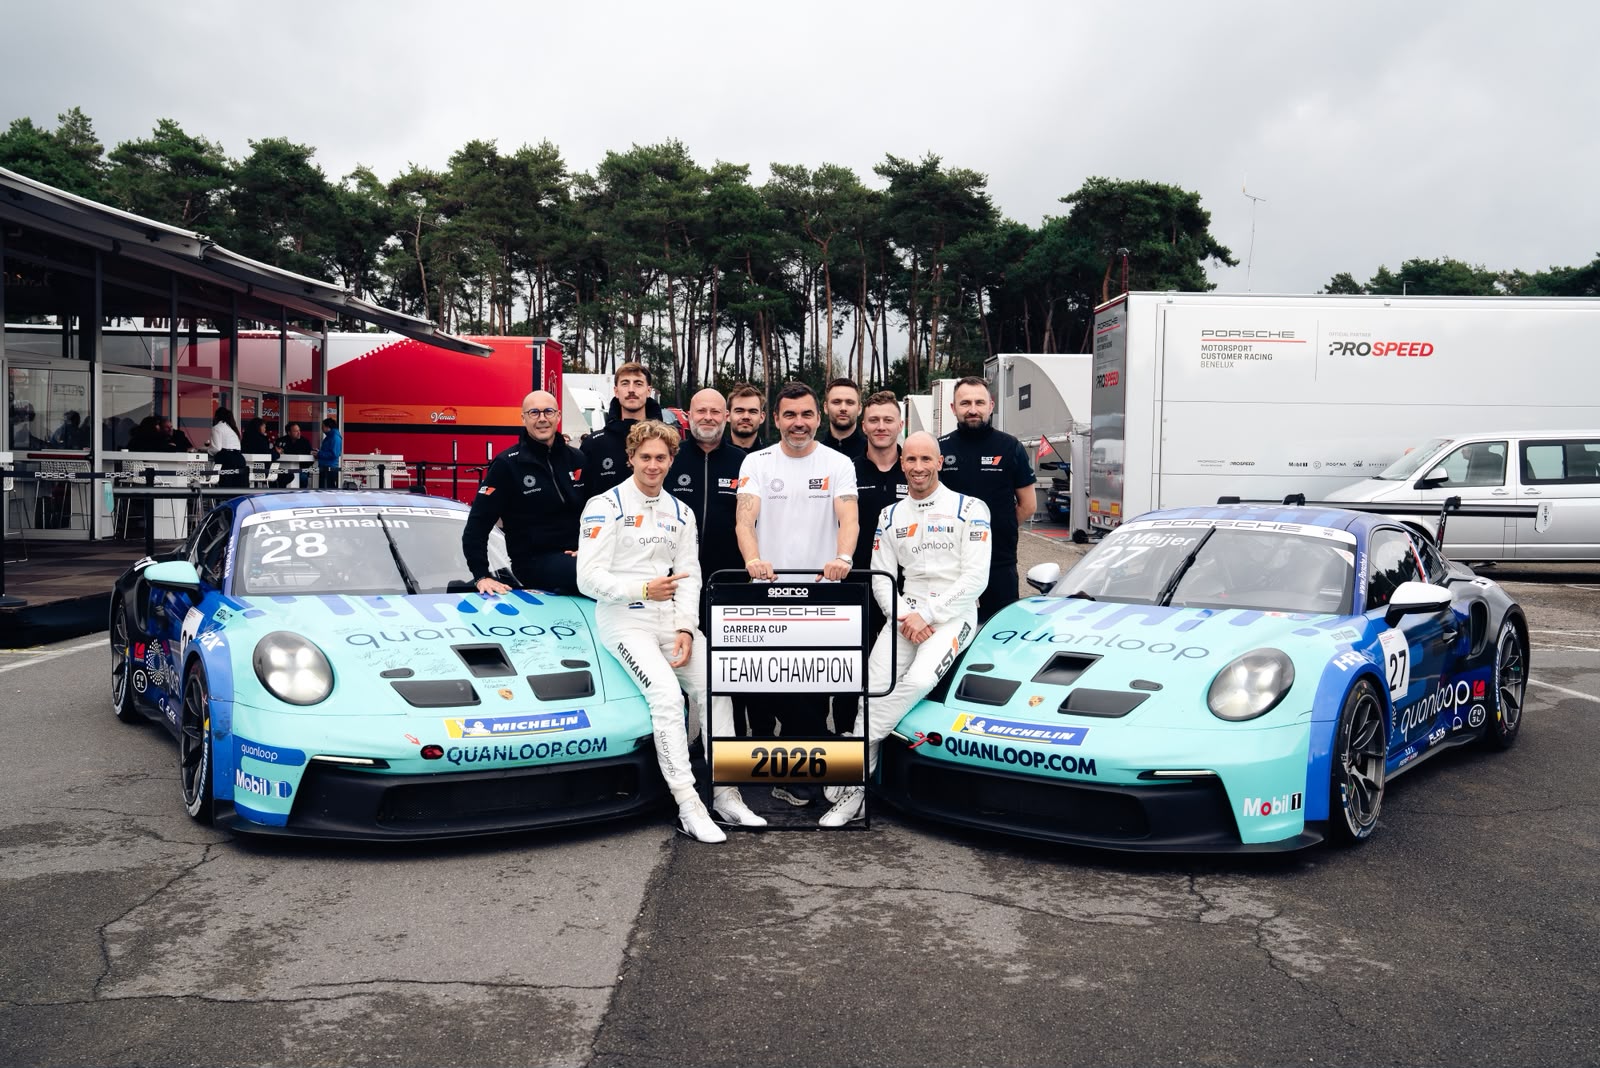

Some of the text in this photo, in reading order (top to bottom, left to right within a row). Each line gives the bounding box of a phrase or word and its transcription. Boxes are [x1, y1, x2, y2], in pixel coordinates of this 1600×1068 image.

[1201, 329, 1295, 338] PORSCHE
[1200, 352, 1273, 361] CUSTOMER RACING
[1201, 344, 1253, 352] MOTORSPORT
[34, 471, 76, 479] PORSCHE
[292, 507, 451, 517] PORSCHE
[254, 517, 410, 538] A. Reimann
[1151, 520, 1303, 533] PORSCHE
[261, 532, 328, 564] 28
[1111, 532, 1198, 549] P. Meijer
[1085, 546, 1151, 570] 27
[768, 587, 809, 598] sparco
[723, 607, 836, 616] PORSCHE
[345, 623, 577, 649] quanloop
[723, 625, 788, 633] CARRERA CUP
[723, 635, 765, 643] BENELUX
[991, 629, 1210, 661] quanloop
[617, 642, 652, 689] REIMANN
[719, 657, 853, 683] TEAM CHAMPION
[1389, 649, 1407, 692] 27
[1400, 680, 1470, 743] quanloop
[492, 716, 578, 732] MICHELIN
[988, 724, 1076, 741] MICHELIN
[240, 743, 278, 762] quanloop
[446, 737, 608, 766] QUANLOOP.COM
[945, 736, 1098, 776] QUANLOOP.COM
[751, 747, 827, 778] 2026
[235, 767, 268, 798] Mobil
[1243, 795, 1289, 817] Mobil
